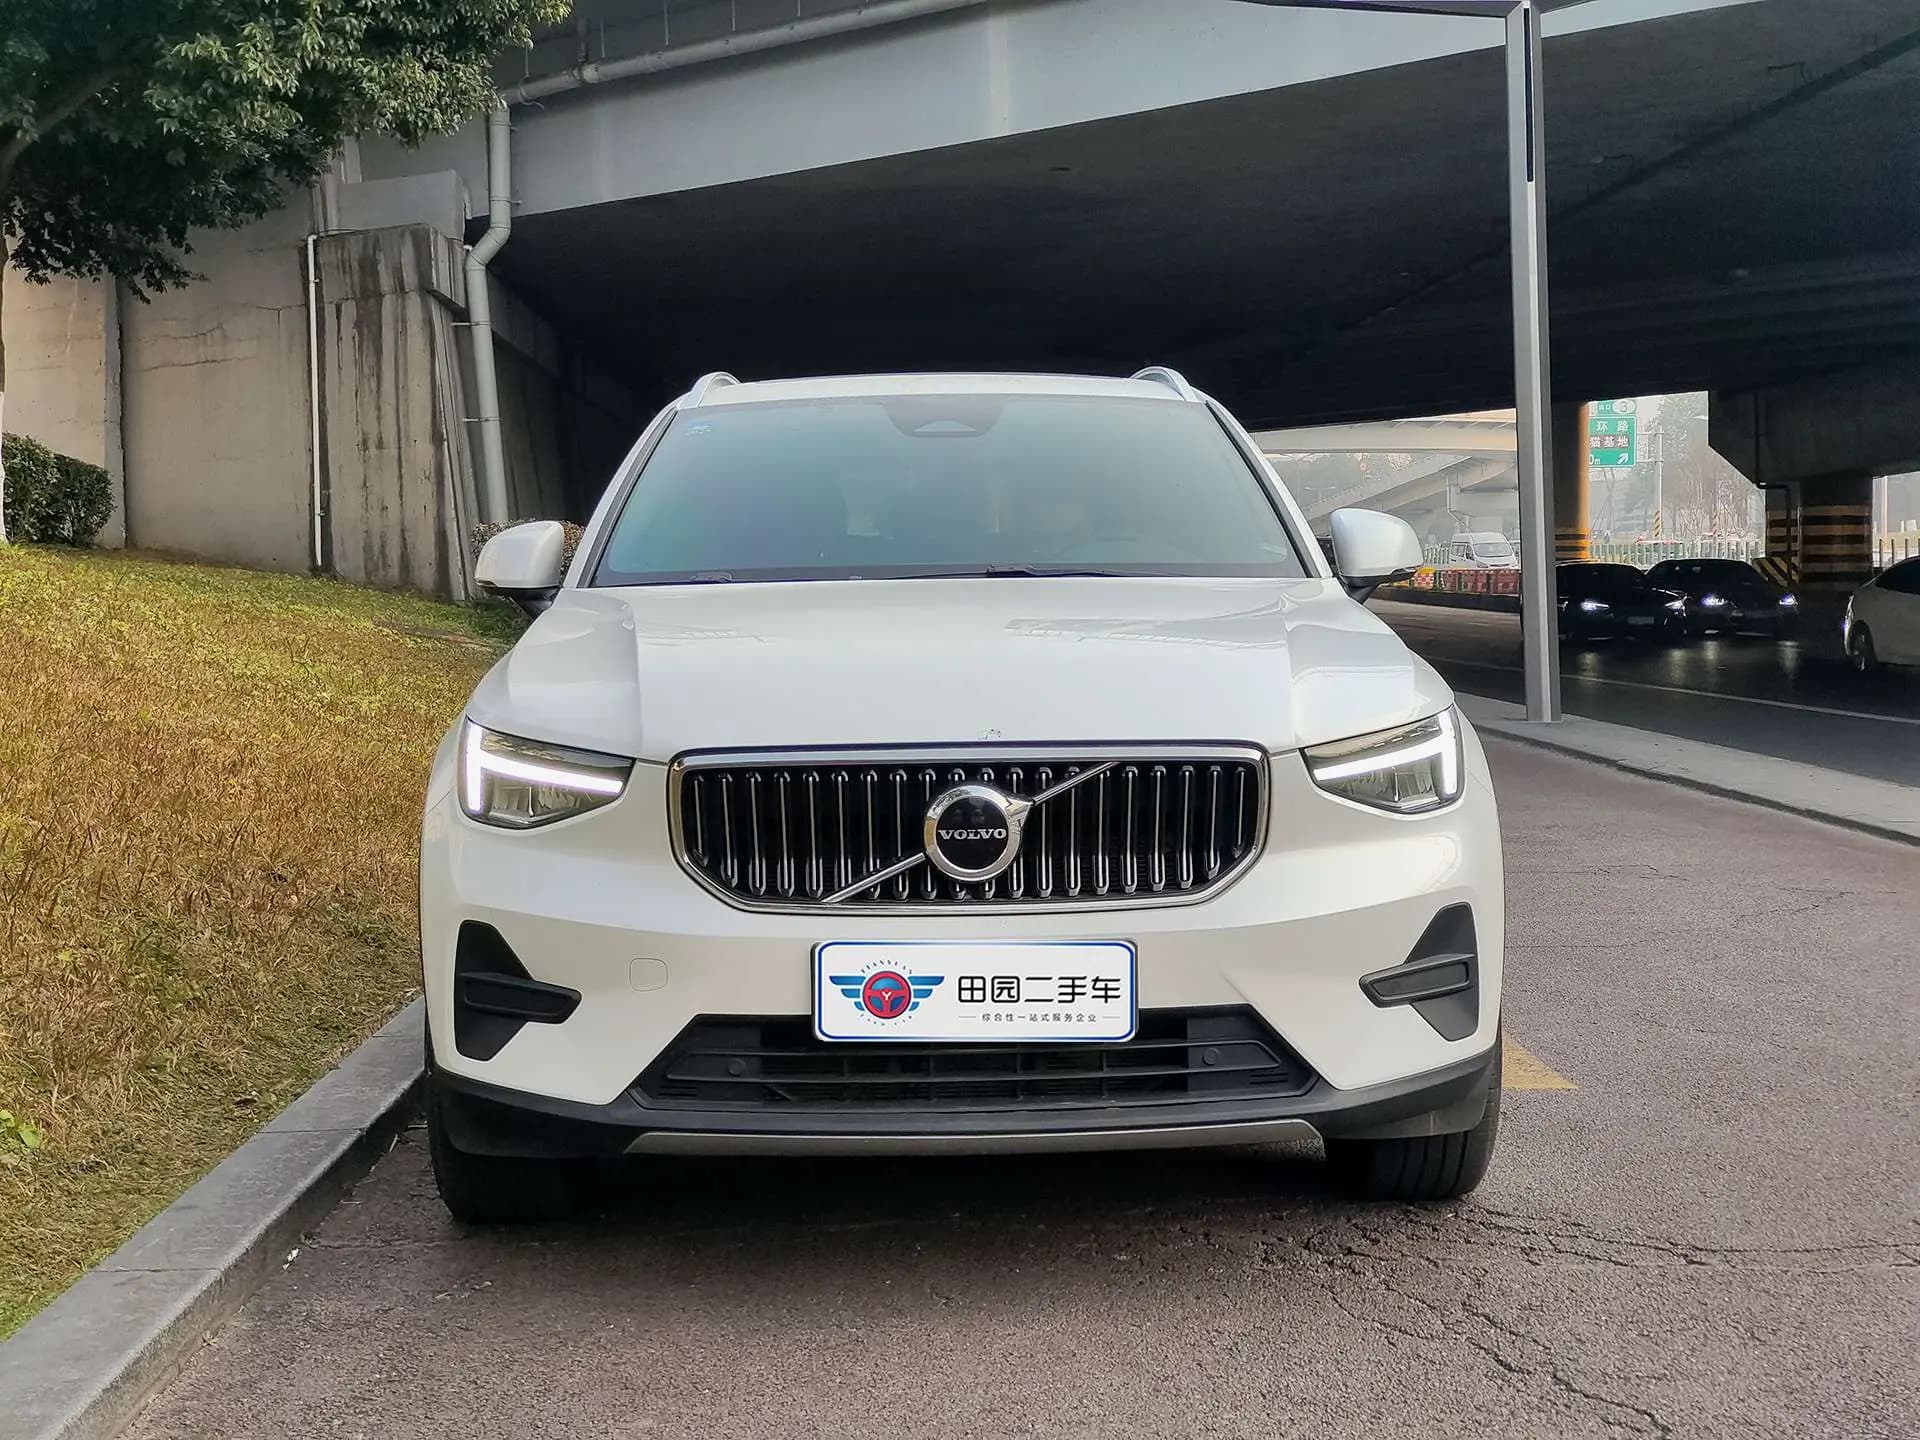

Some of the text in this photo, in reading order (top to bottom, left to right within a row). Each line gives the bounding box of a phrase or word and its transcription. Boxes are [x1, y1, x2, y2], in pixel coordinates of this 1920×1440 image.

[1620, 401, 1627, 413] 3
[938, 828, 1007, 840] VOLVO
[958, 975, 1121, 1004] 田园二手车
[982, 1013, 1097, 1023] 综合性一站式服务企业
